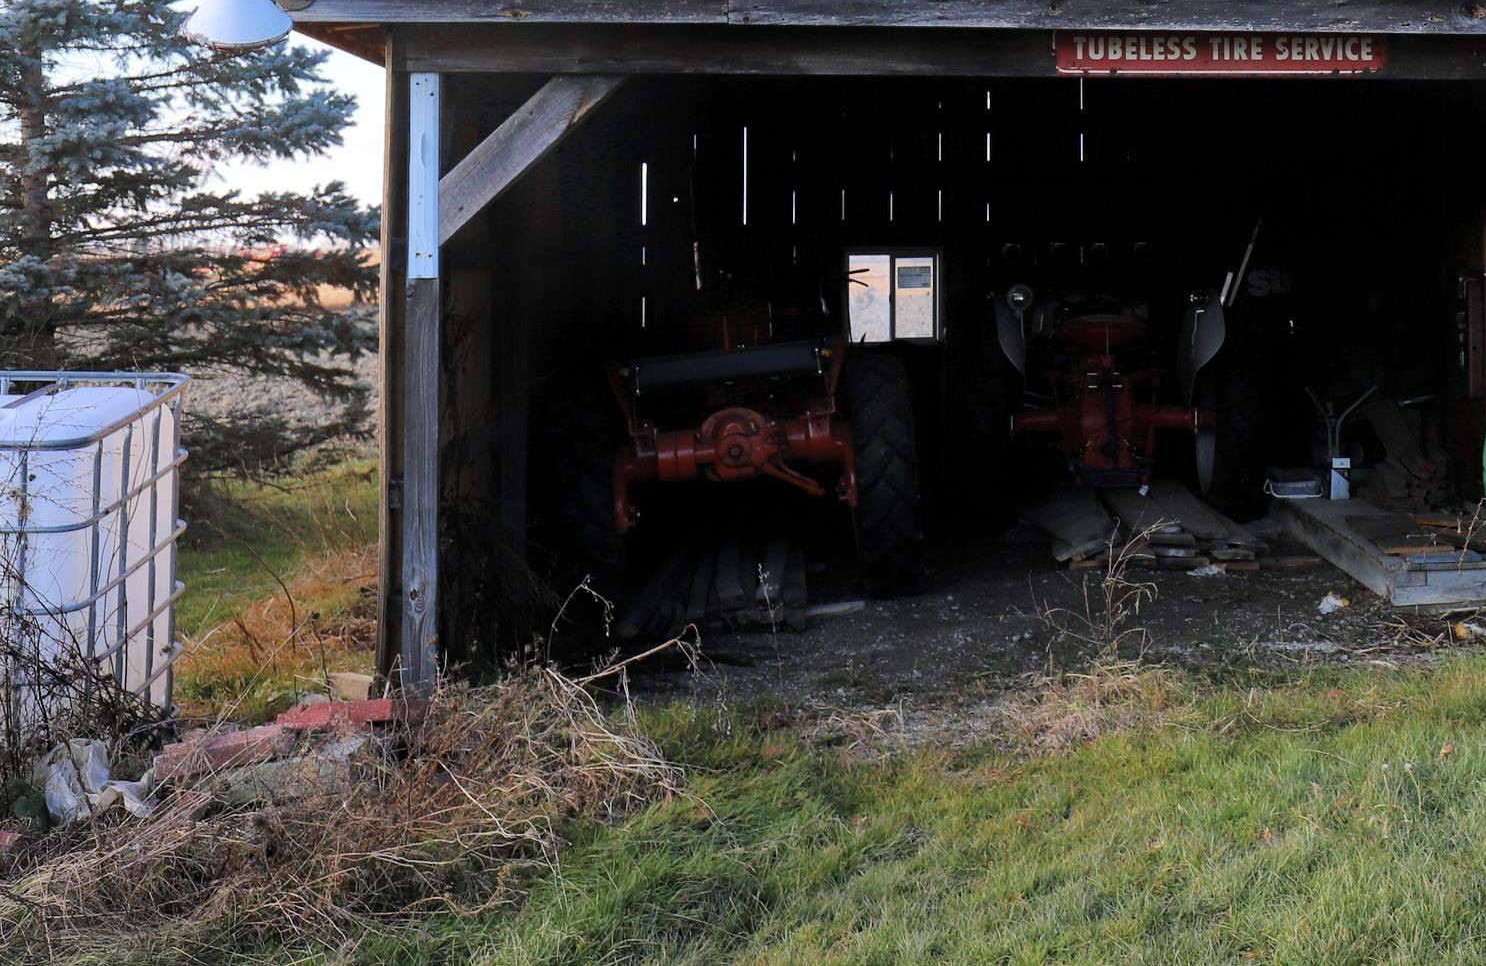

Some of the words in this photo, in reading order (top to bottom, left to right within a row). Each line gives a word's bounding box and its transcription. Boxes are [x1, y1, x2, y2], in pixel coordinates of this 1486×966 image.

[1073, 36, 1197, 61] TUBELESS
[1209, 36, 1263, 61] TIRE
[1275, 36, 1373, 61] SERVICE
